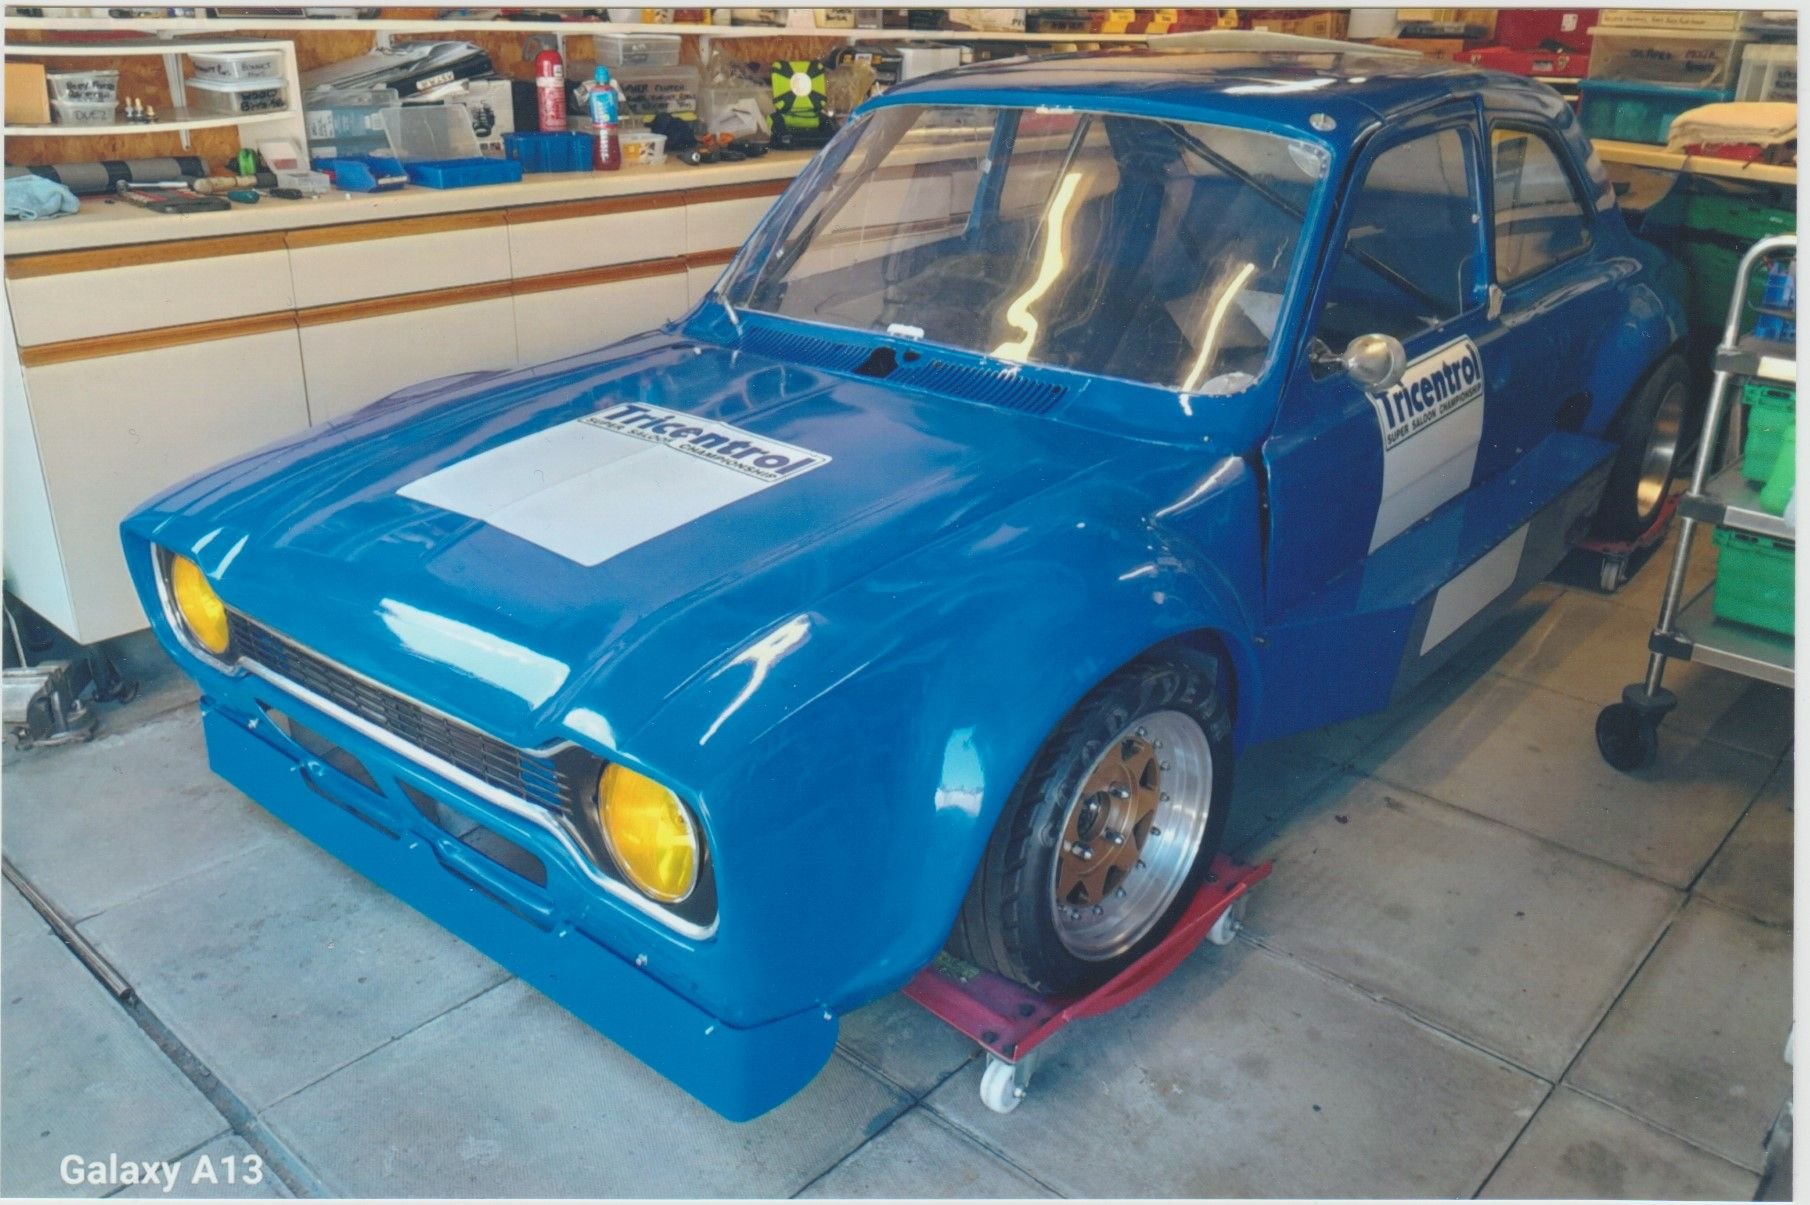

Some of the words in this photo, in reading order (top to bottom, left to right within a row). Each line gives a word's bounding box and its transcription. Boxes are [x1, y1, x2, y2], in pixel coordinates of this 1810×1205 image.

[1374, 344, 1481, 430] Tricentrol
[1387, 424, 1409, 445] SUPER
[1412, 409, 1437, 431] SALOON
[1439, 383, 1482, 415] CHAMPIONSHIP
[586, 417, 625, 431] SUPER
[679, 443, 778, 479] CHAMPIONSHIP
[603, 404, 816, 475] Tricentrol
